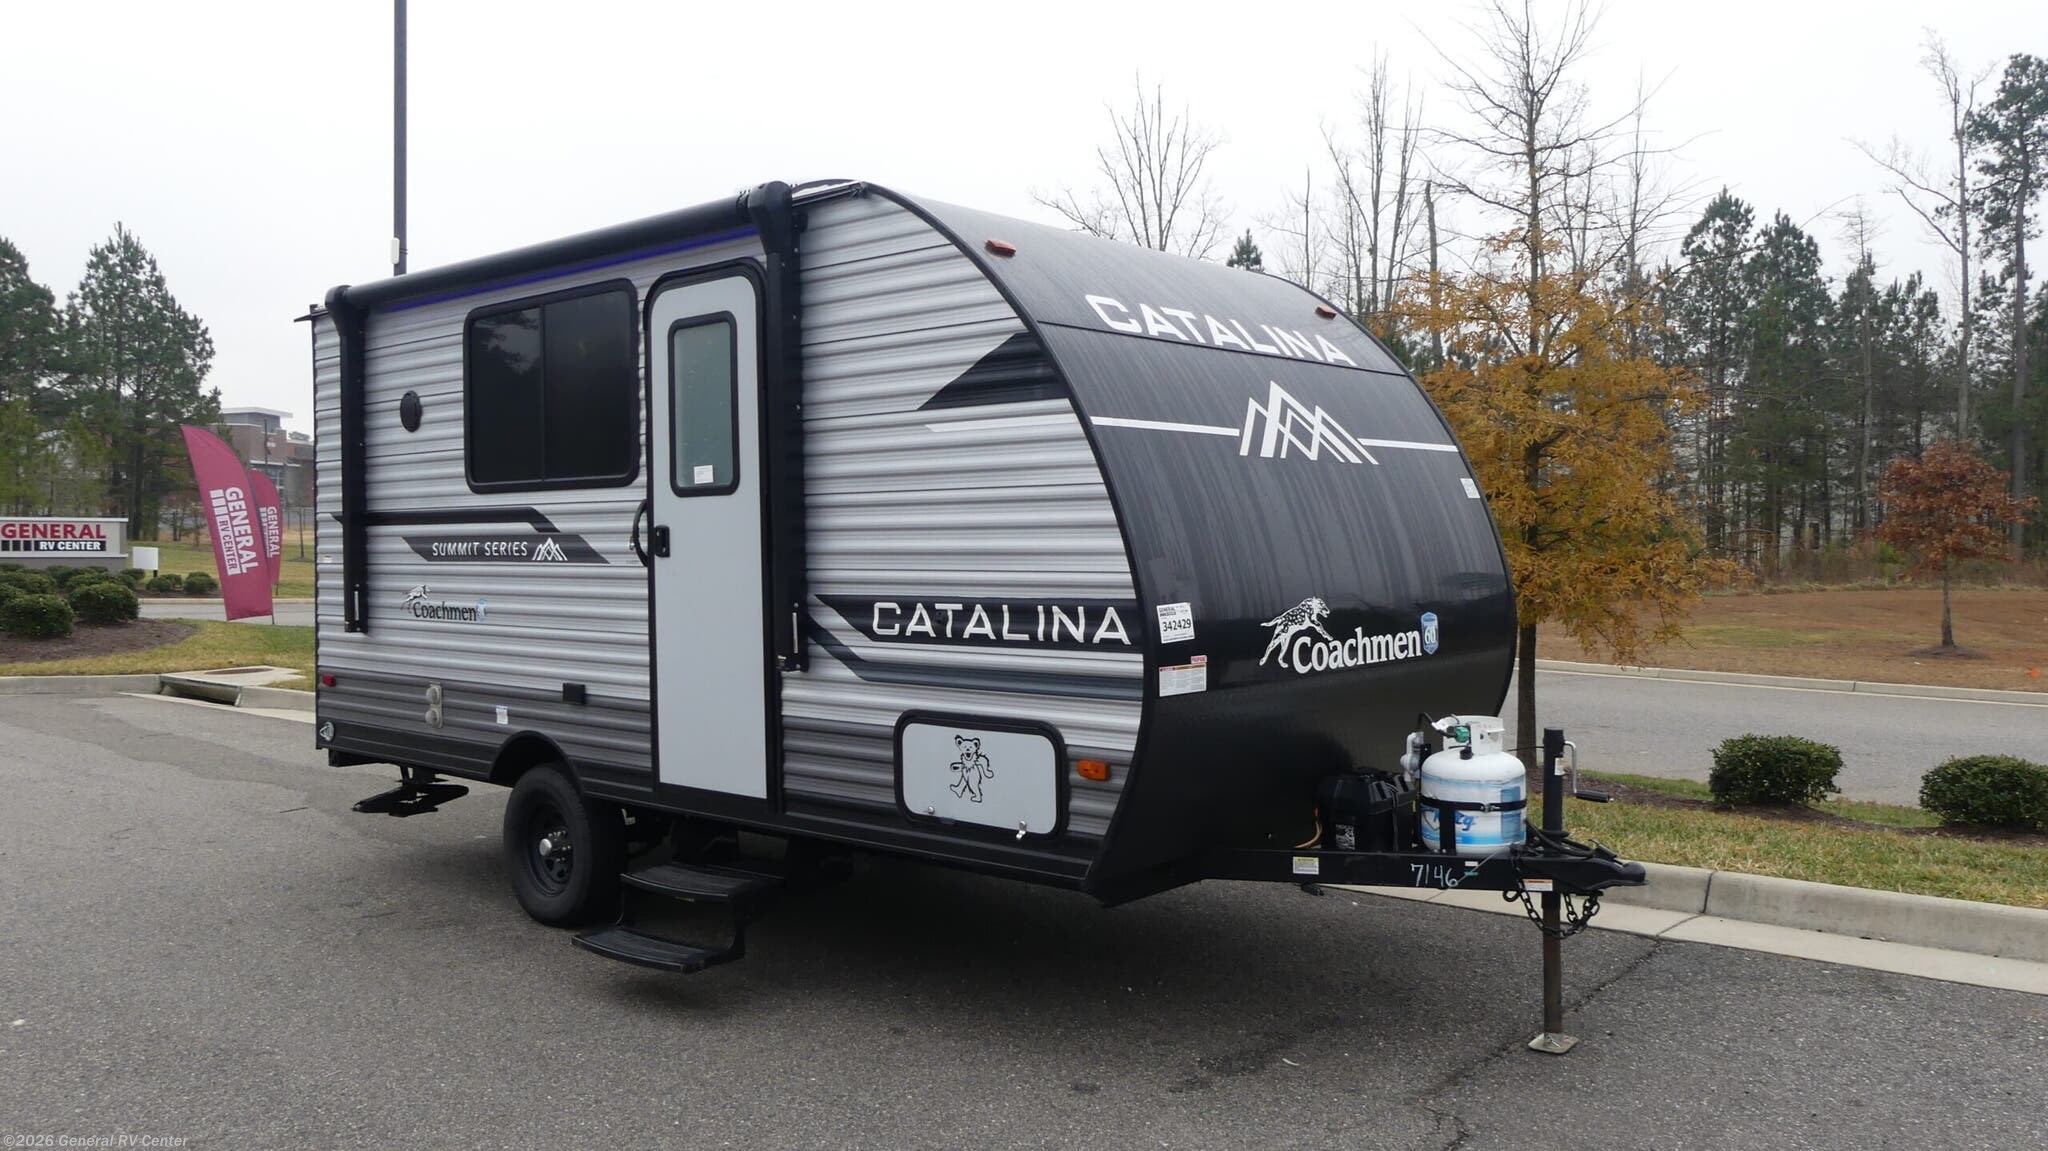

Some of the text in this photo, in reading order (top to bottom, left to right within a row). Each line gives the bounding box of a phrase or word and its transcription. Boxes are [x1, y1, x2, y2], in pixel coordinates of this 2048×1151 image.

[1085, 294, 1358, 367] CATALINA
[0, 523, 107, 539] GENERAL
[39, 541, 101, 551] RV CENTER
[218, 520, 238, 570] RV CENTER
[225, 486, 259, 574] GENERAL
[266, 505, 281, 558] GENERAL
[432, 541, 528, 556] SUMMIT SERIES
[413, 600, 477, 621] Coachmen
[872, 601, 1132, 645] CATALINA
[1162, 618, 1192, 632] 342429
[1292, 626, 1422, 674] Coachmen
[1410, 863, 1459, 888] 7146
